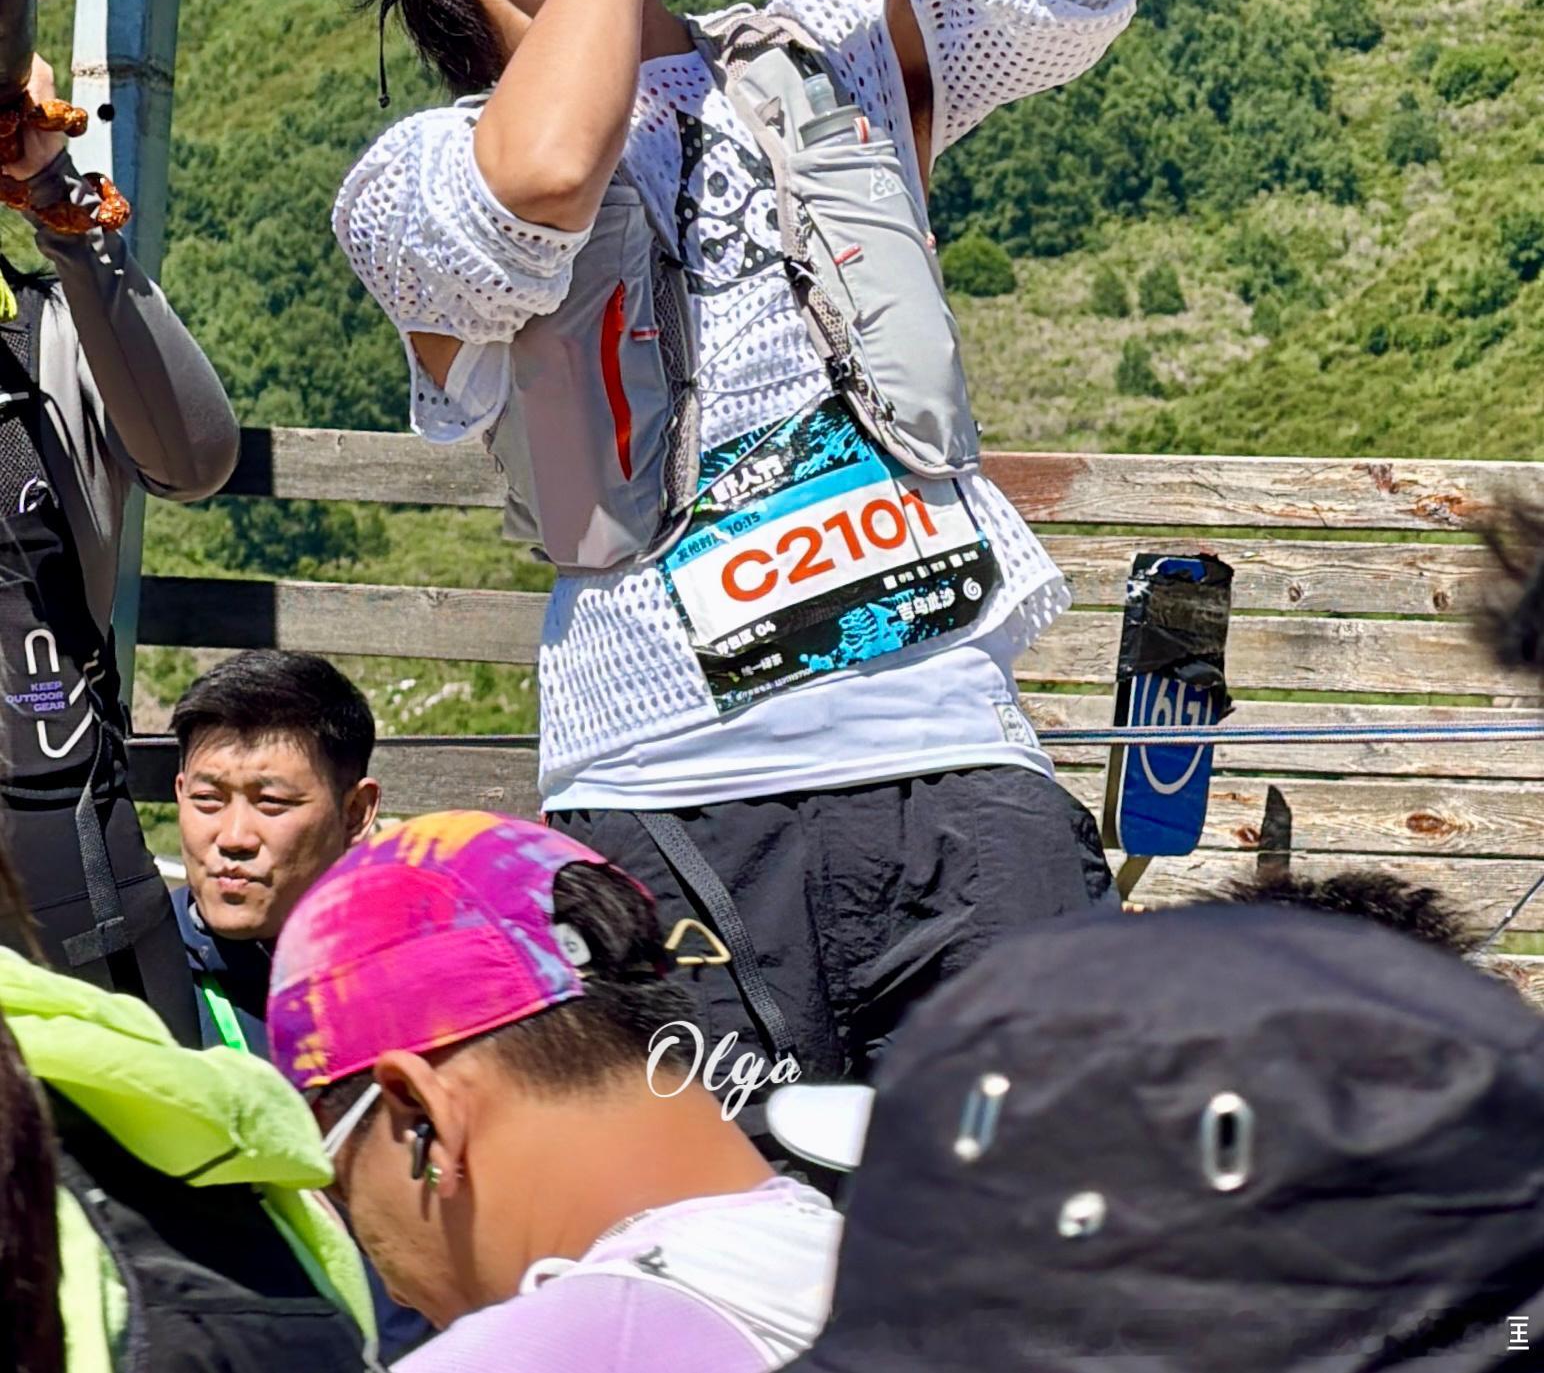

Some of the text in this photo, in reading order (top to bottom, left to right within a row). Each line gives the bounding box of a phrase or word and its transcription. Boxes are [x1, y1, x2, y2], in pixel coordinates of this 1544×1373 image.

[726, 510, 762, 536] 10:15
[720, 489, 939, 602] C2101
[31, 681, 62, 691] KEEP
[6, 692, 64, 703] OUTDOOR
[34, 701, 65, 712] GEAR
